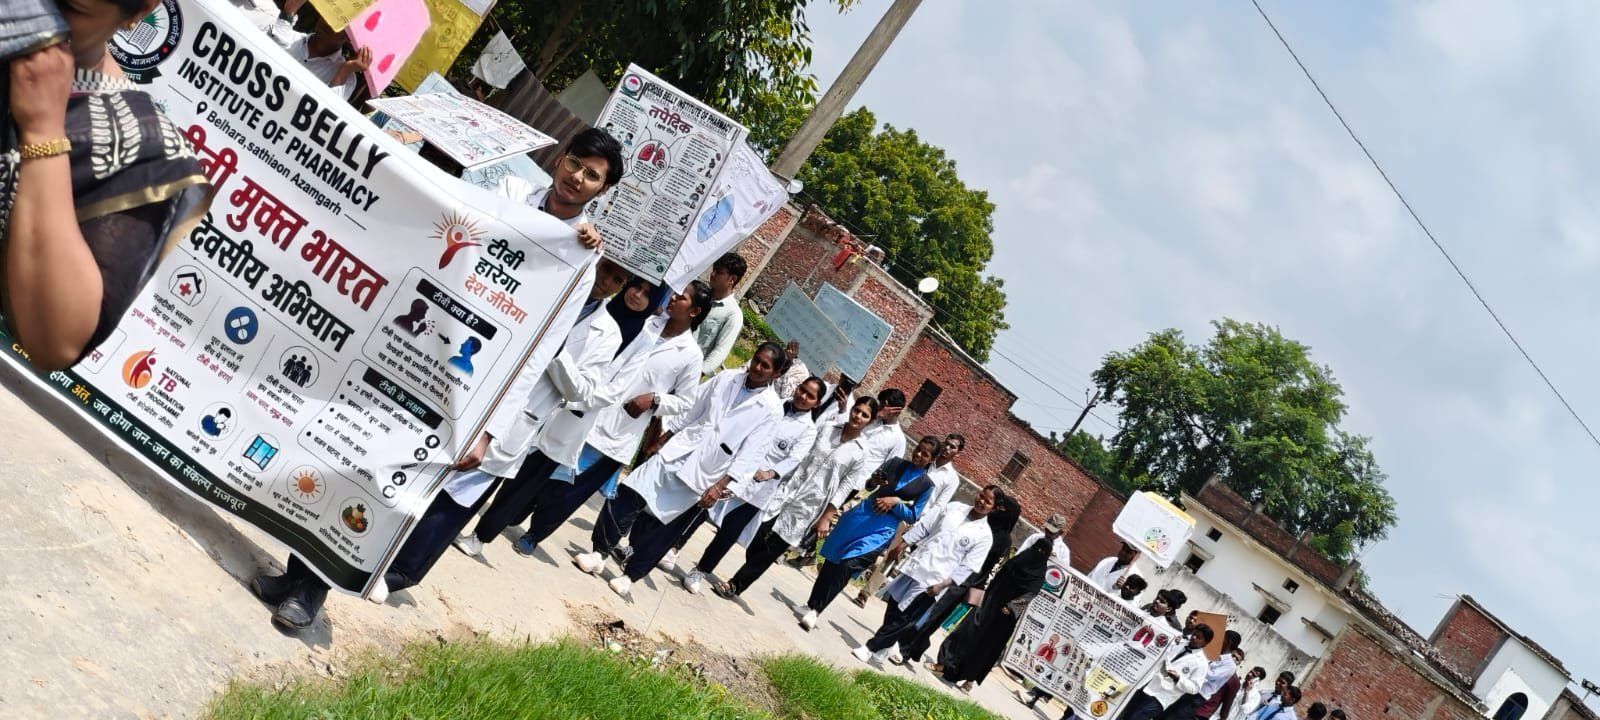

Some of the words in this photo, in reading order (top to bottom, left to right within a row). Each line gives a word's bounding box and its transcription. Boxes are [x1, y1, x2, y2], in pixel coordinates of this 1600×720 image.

[192, 20, 290, 112] CROSS
[289, 93, 389, 180] BELLY
[661, 90, 678, 104] BELLY
[677, 99, 702, 117] INSTITUTE
[176, 57, 270, 130] INSTITUTE
[261, 119, 288, 144] OF
[284, 136, 380, 212] PHARMACY
[648, 105, 694, 134] तपेदिक
[205, 110, 291, 178] Belhara,sathiaon
[289, 172, 341, 215] Azamgarh
[179, 123, 240, 195] ीबी
[225, 175, 309, 252] मुक्त
[300, 229, 389, 312] भारत
[486, 238, 525, 270] टीबी
[474, 256, 521, 294] हारेगा
[261, 273, 355, 352] अभियान
[432, 291, 450, 308] टीबी
[450, 304, 466, 318] क्या
[465, 313, 478, 326] है?
[464, 272, 488, 297] देश
[485, 289, 528, 324] जीतेगा
[71, 384, 91, 404] अंत,
[157, 372, 177, 392] TB
[165, 366, 191, 388] NATIONAL
[265, 374, 279, 387] टीबी
[145, 391, 180, 418] PROGRAMME
[150, 384, 184, 412] ELIMINATION
[378, 380, 396, 396] टीबी
[396, 390, 406, 402] के
[405, 401, 426, 417] लक्षण
[92, 398, 111, 416] जब
[108, 410, 133, 431] होगा
[131, 426, 170, 459] जन-जन
[169, 454, 184, 469] का
[182, 464, 212, 491] संकल्प
[212, 485, 247, 510] मजबूत
[1068, 593, 1080, 605] टी.
[1082, 601, 1093, 614] बी.
[1095, 610, 1114, 625] (क्षय
[1114, 620, 1131, 636] रोग)
